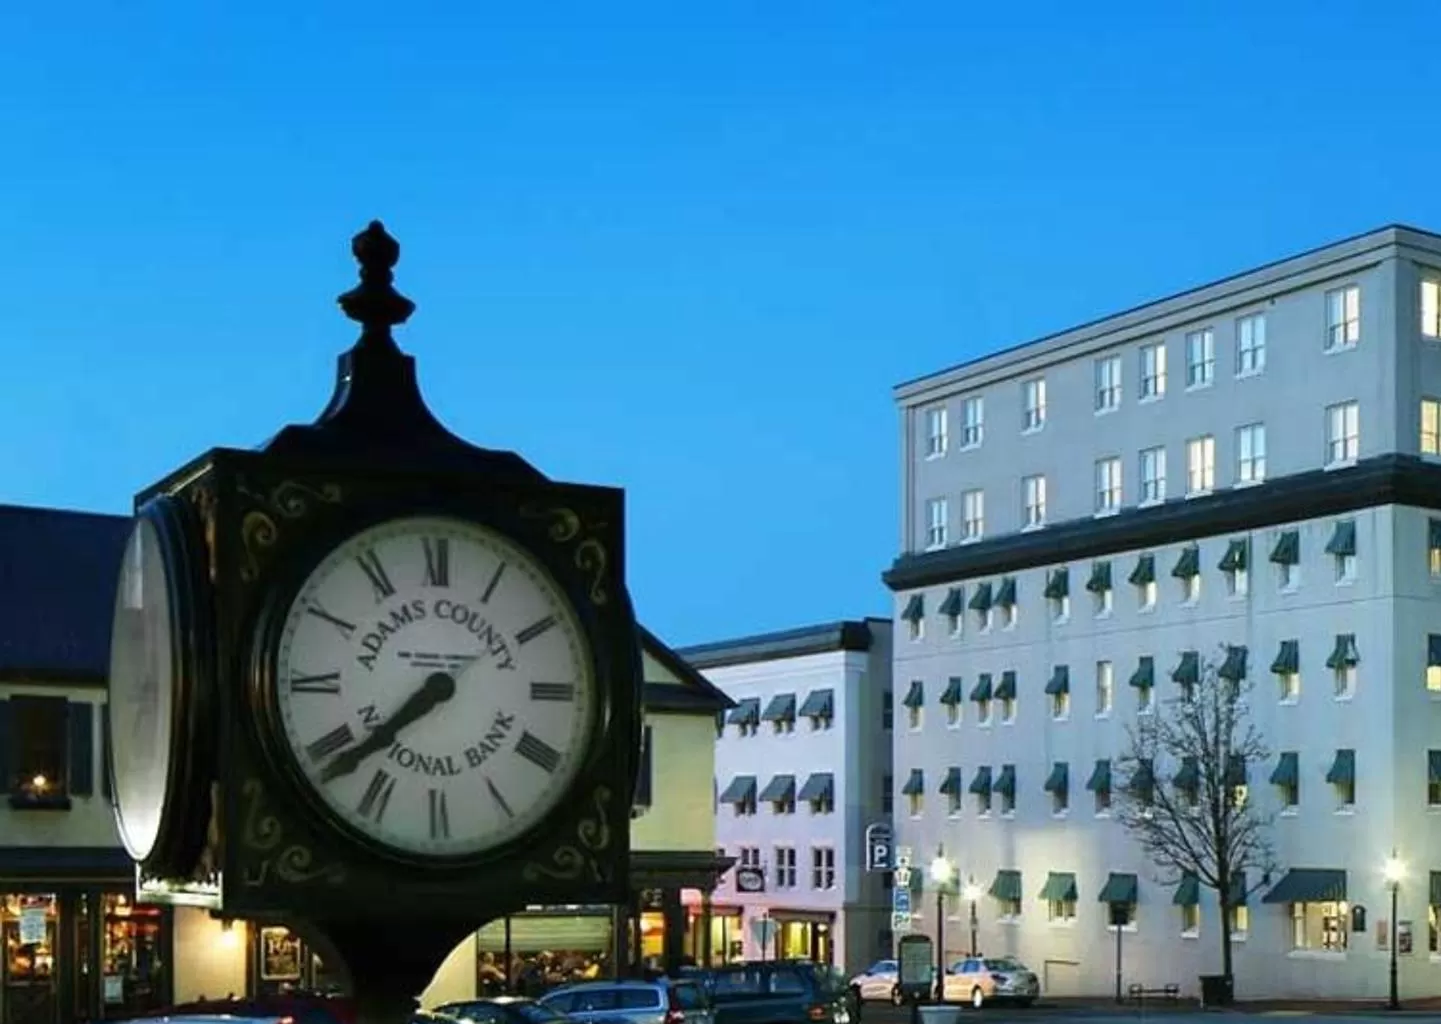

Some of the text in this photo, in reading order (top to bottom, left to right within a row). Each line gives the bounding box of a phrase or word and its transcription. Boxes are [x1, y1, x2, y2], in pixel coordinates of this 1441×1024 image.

[356, 598, 516, 672] ADAMS COUNTY
[357, 702, 515, 777] NIONAL BANK
[874, 844, 888, 862] P
